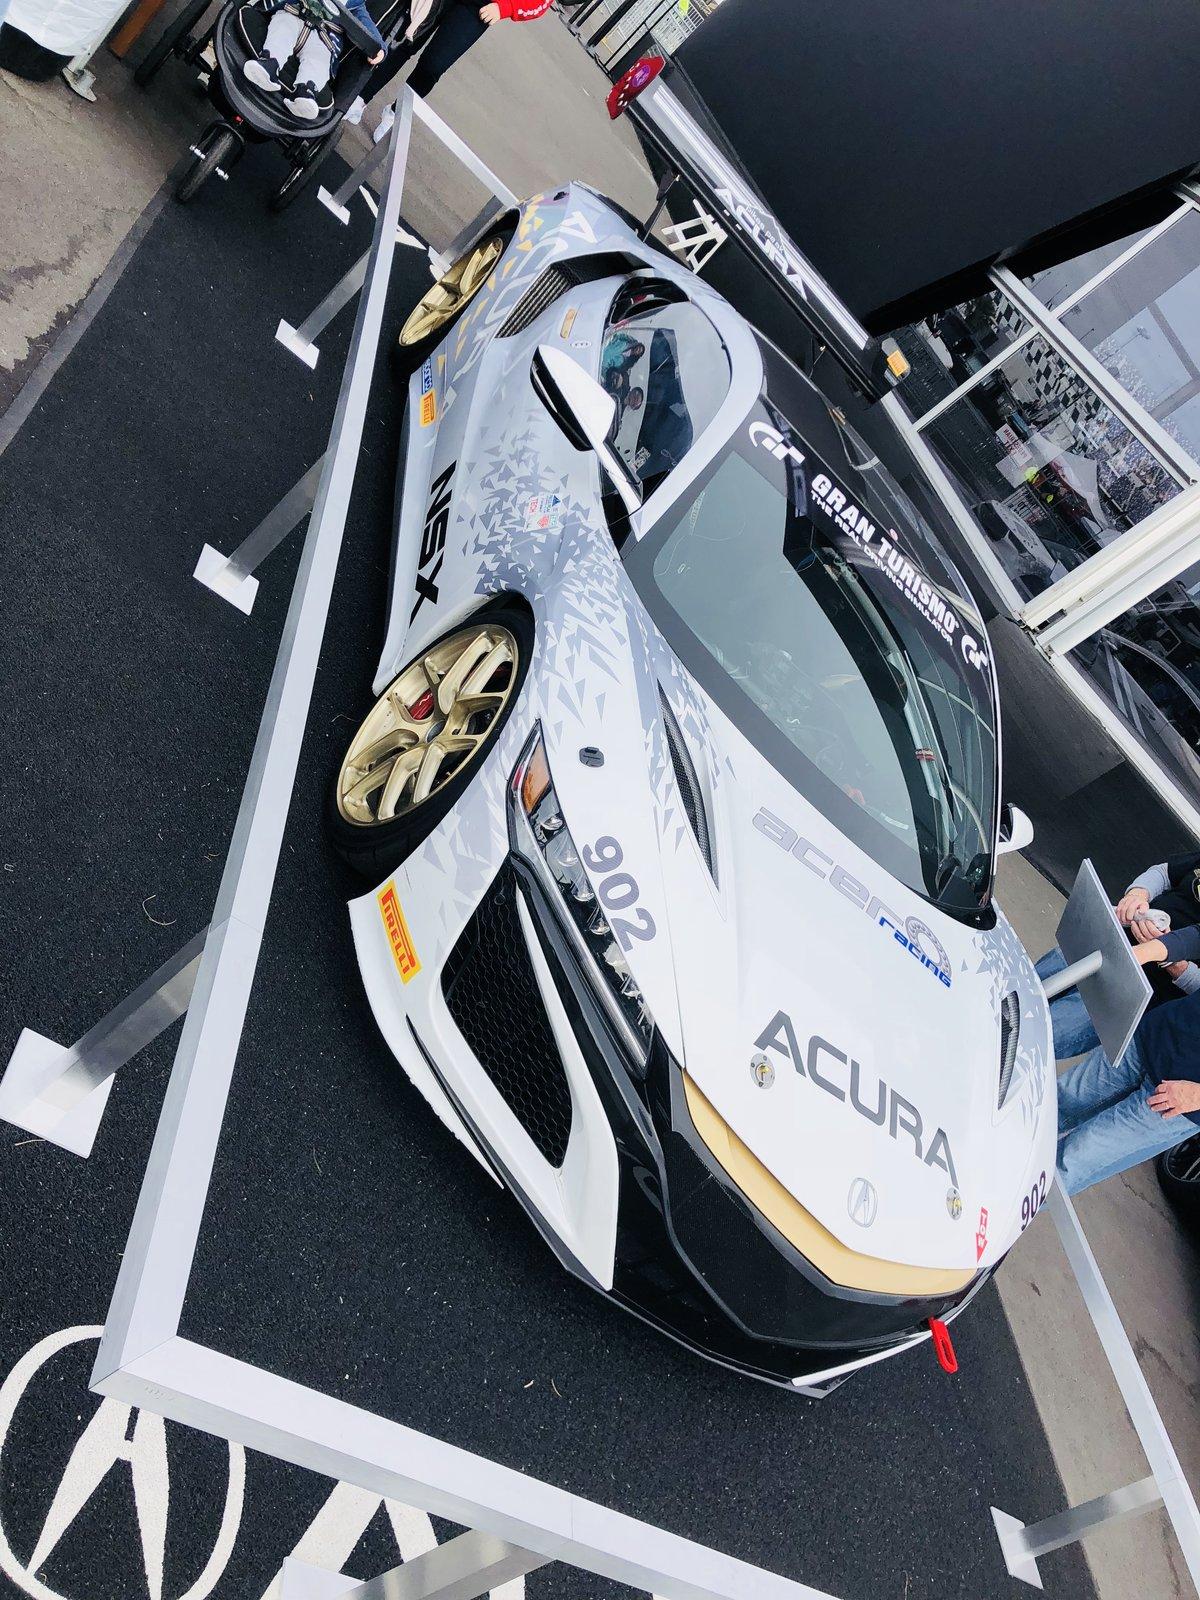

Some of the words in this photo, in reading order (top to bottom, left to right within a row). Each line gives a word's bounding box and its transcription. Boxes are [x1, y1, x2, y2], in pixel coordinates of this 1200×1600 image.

[423, 393, 435, 424] PIRELLI
[409, 460, 457, 628] NSX
[810, 489, 833, 518] THE
[834, 515, 862, 547] REAL
[863, 545, 904, 592] DRIVING
[904, 590, 953, 647] SIMULATOR
[811, 473, 876, 543] GRAN
[877, 537, 957, 634] TURISMO
[380, 887, 417, 976] PIRELLI
[582, 835, 657, 952] 902
[753, 1010, 961, 1188] ACURA
[1021, 1170, 1046, 1231] 902
